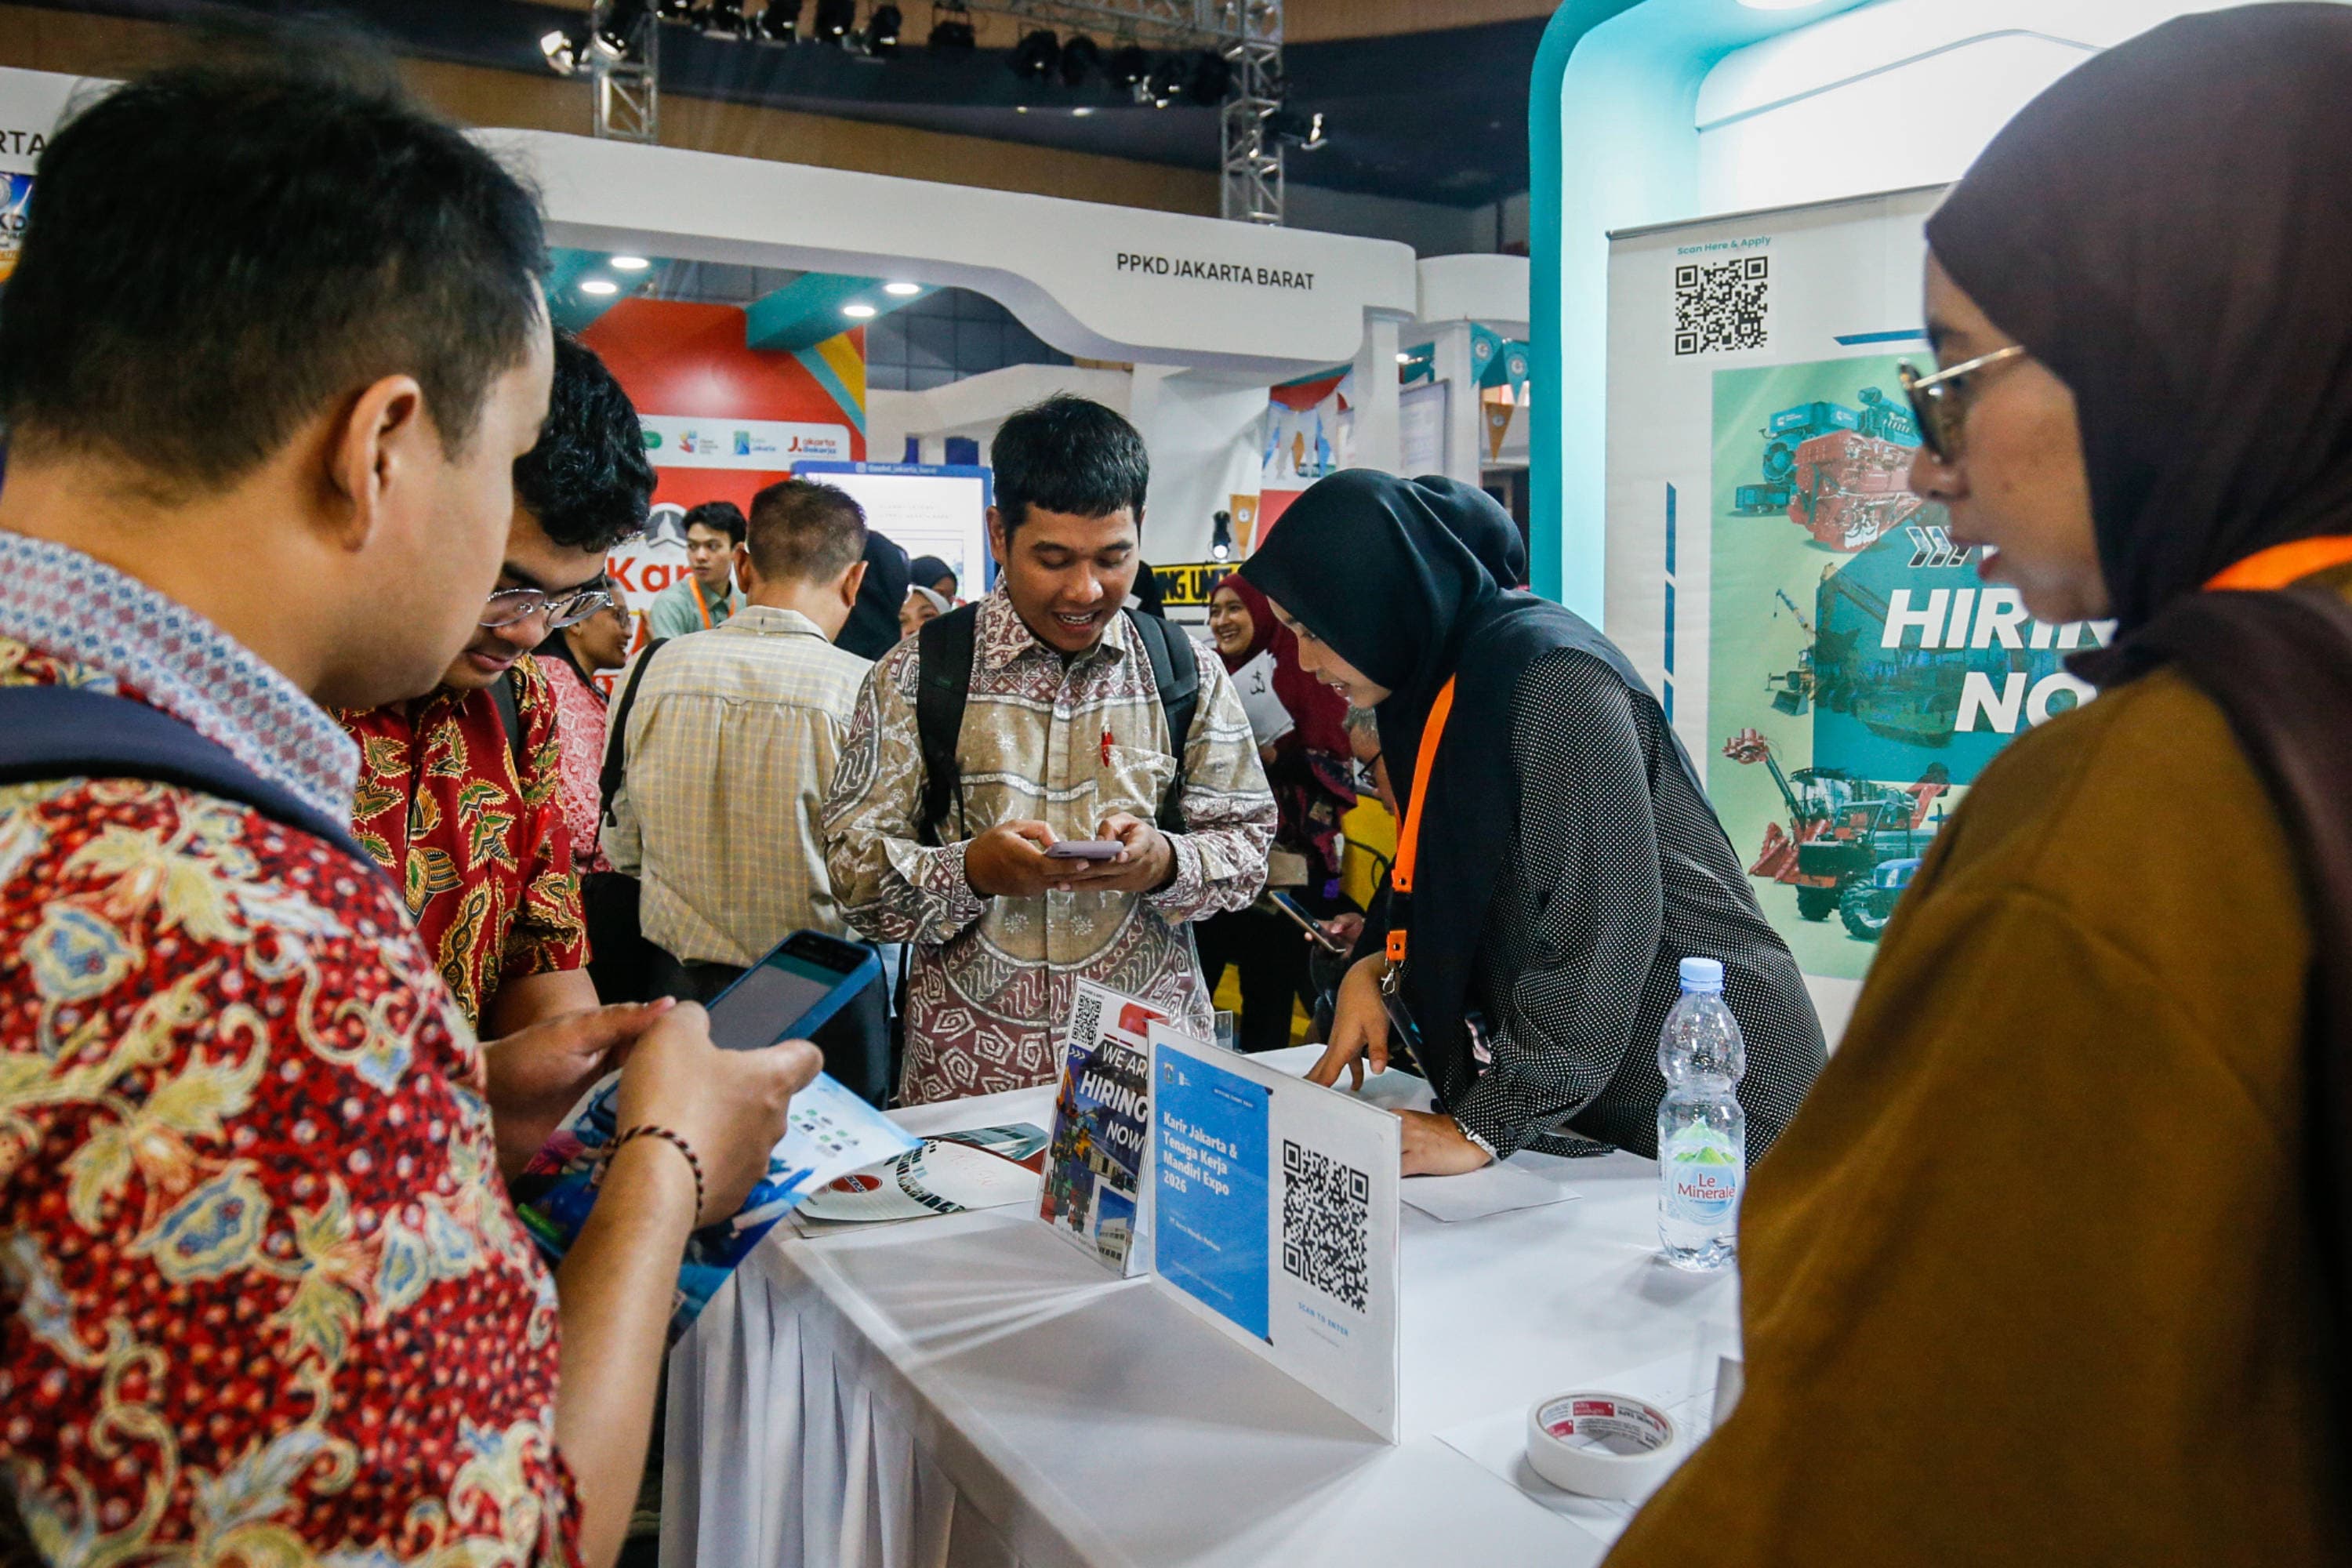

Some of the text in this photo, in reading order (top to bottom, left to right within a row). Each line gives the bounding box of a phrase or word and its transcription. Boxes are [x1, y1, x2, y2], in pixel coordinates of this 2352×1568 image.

[1678, 235, 1770, 255] Scan Here & Apply
[1117, 253, 1314, 290] PPKD JAKARTA BARAT
[1102, 1042, 1148, 1080] WE AR
[1080, 1070, 1148, 1123] HIRING
[1105, 1120, 1146, 1155] NOW
[1163, 1111, 1238, 1160] Karir Jakarta &
[1163, 1131, 1228, 1175] Tenaga Kerja
[1163, 1150, 1229, 1196] Mandiri Expo
[1163, 1170, 1187, 1193] 2026
[1678, 1182, 1736, 1200] Minerale
[1697, 1173, 1716, 1188] Le
